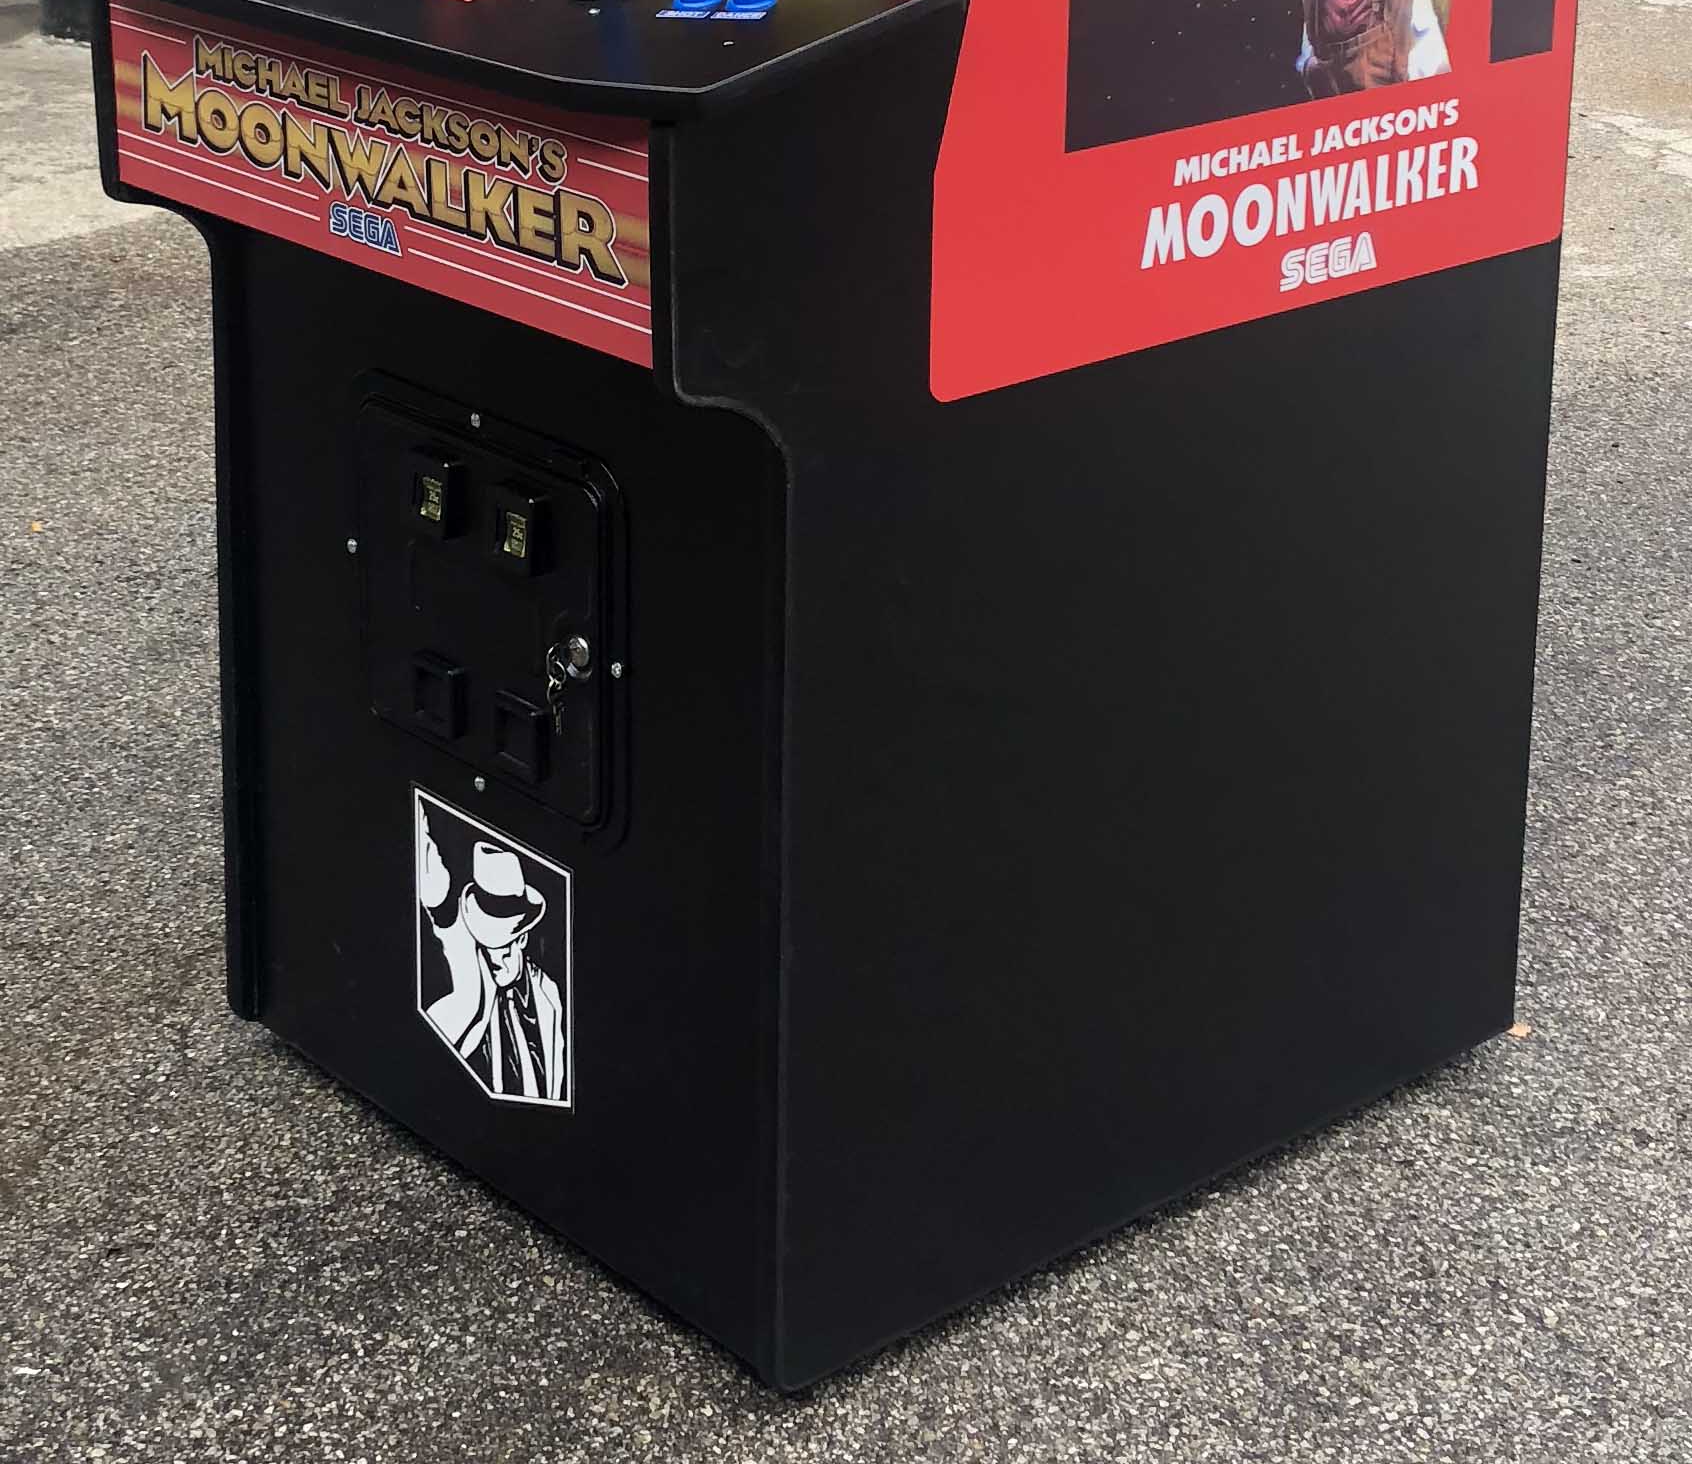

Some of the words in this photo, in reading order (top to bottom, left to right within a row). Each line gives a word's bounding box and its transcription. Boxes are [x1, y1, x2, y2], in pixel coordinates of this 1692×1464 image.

[193, 34, 353, 120] MICHAEL
[354, 83, 568, 184] JACKSON'S
[1174, 133, 1302, 187] MICHAEL
[1310, 98, 1460, 156] JACKSON'S
[142, 51, 630, 288] MOONWALKER
[1140, 136, 1480, 270] MOONWALKER
[328, 202, 402, 256] SEGA
[1279, 231, 1377, 292] SEGA
